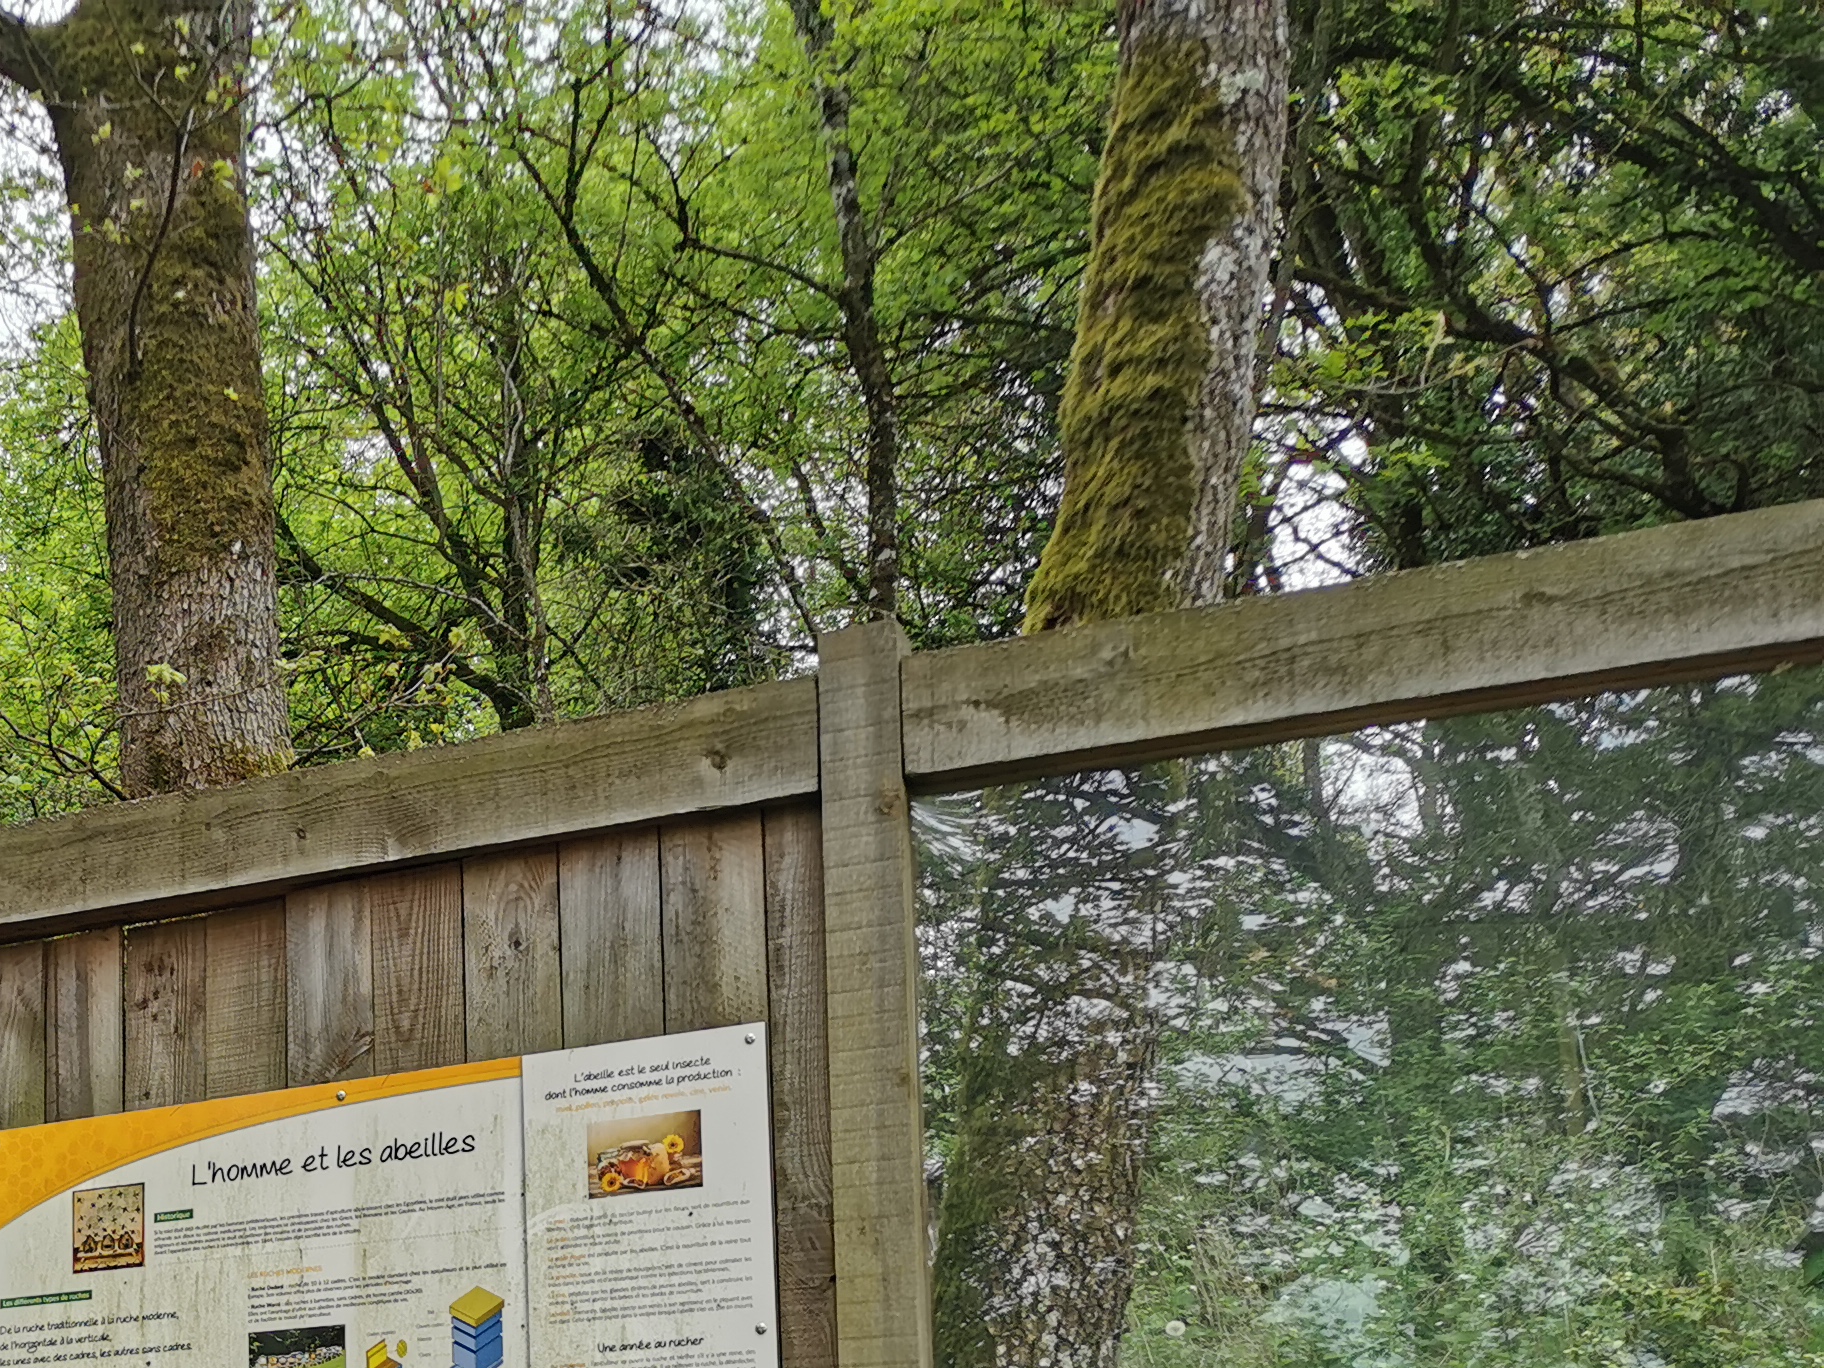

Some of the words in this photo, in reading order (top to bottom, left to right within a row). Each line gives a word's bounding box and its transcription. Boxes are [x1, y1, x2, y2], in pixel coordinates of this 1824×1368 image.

[574, 1069, 614, 1083] L'abeille
[618, 1066, 635, 1077] est
[638, 1064, 646, 1075] le
[650, 1061, 669, 1073] seul
[672, 1056, 711, 1069] insecte
[544, 1087, 566, 1101] dont
[611, 1078, 663, 1093] consomme
[665, 1075, 675, 1085] la
[676, 1068, 732, 1086] production
[191, 1158, 293, 1186] L'homme
[301, 1146, 329, 1172] et
[336, 1145, 372, 1168] les
[379, 1131, 476, 1163] abeilles
[0, 1326, 12, 1335] De
[14, 1326, 20, 1334] la
[22, 1323, 45, 1334] ruche
[47, 1319, 98, 1330] traditionnelle
[101, 1317, 106, 1325] à
[107, 1316, 114, 1324] la
[116, 1314, 139, 1324] ruche
[0, 1343, 9, 1351] de
[60, 1336, 64, 1345] à
[66, 1336, 73, 1345] la
[598, 1343, 617, 1353] Une
[619, 1340, 650, 1351] année
[655, 1340, 667, 1350] au
[669, 1336, 704, 1348] rucher
[0, 1358, 11, 1367] les
[53, 1353, 67, 1362] des
[100, 1349, 112, 1358] les
[114, 1346, 139, 1356] autres
[142, 1345, 161, 1354] sans
